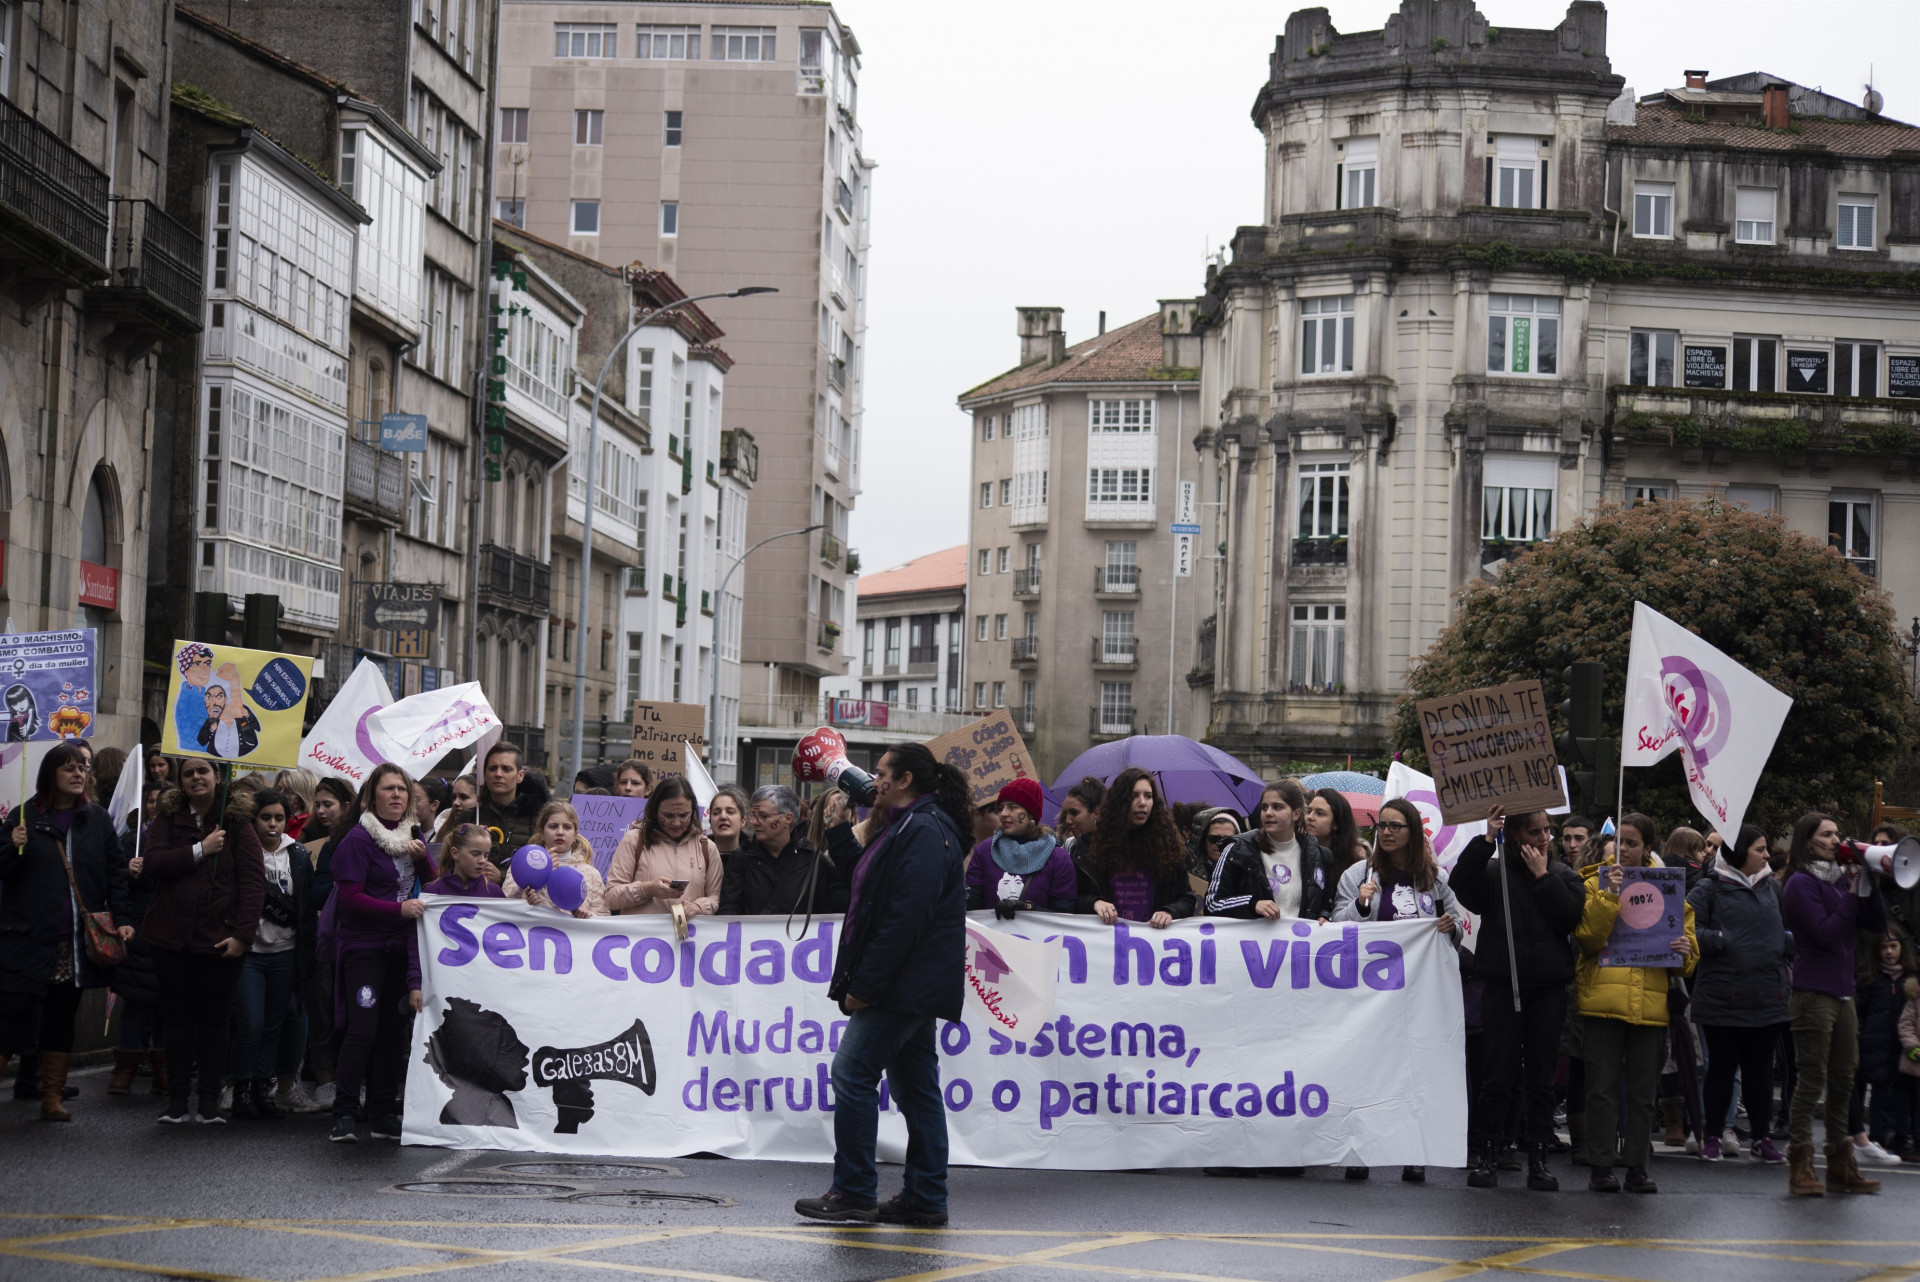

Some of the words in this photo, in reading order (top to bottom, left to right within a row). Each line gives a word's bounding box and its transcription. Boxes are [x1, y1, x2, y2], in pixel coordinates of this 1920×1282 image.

[1686, 355, 1705, 363] LIBRE
[1686, 362, 1725, 370] VIOLENCIAS
[1686, 369, 1723, 377] MACHISTAS
[487, 328, 508, 482] FORNOS
[383, 428, 424, 440] BASE
[86, 573, 115, 601] Santander
[372, 586, 433, 601] VIAJES
[24, 632, 82, 643] MACHISMO,
[24, 644, 83, 655] COMBATIVO
[58, 659, 87, 667] muller
[273, 662, 283, 674] NIN
[263, 671, 273, 683] NIN
[254, 682, 264, 694] NIN
[638, 705, 662, 722] Tu
[1423, 694, 1514, 740] DESNUDA
[1514, 688, 1543, 721] TE
[633, 725, 703, 745] Patriarcado
[1450, 727, 1536, 764] INCOMODA
[633, 747, 654, 760] me
[661, 748, 677, 762] da
[1440, 764, 1520, 809] ¿MUERTA
[1523, 754, 1558, 790] NO?
[582, 800, 625, 818] NON
[1629, 893, 1653, 906] 100%
[437, 903, 572, 975] Sen
[1113, 922, 1217, 986] hai
[1240, 921, 1405, 991] vida
[540, 1033, 648, 1085] Galegas8M
[992, 1079, 1021, 1112] o
[1039, 1069, 1329, 1130] patriarcado
